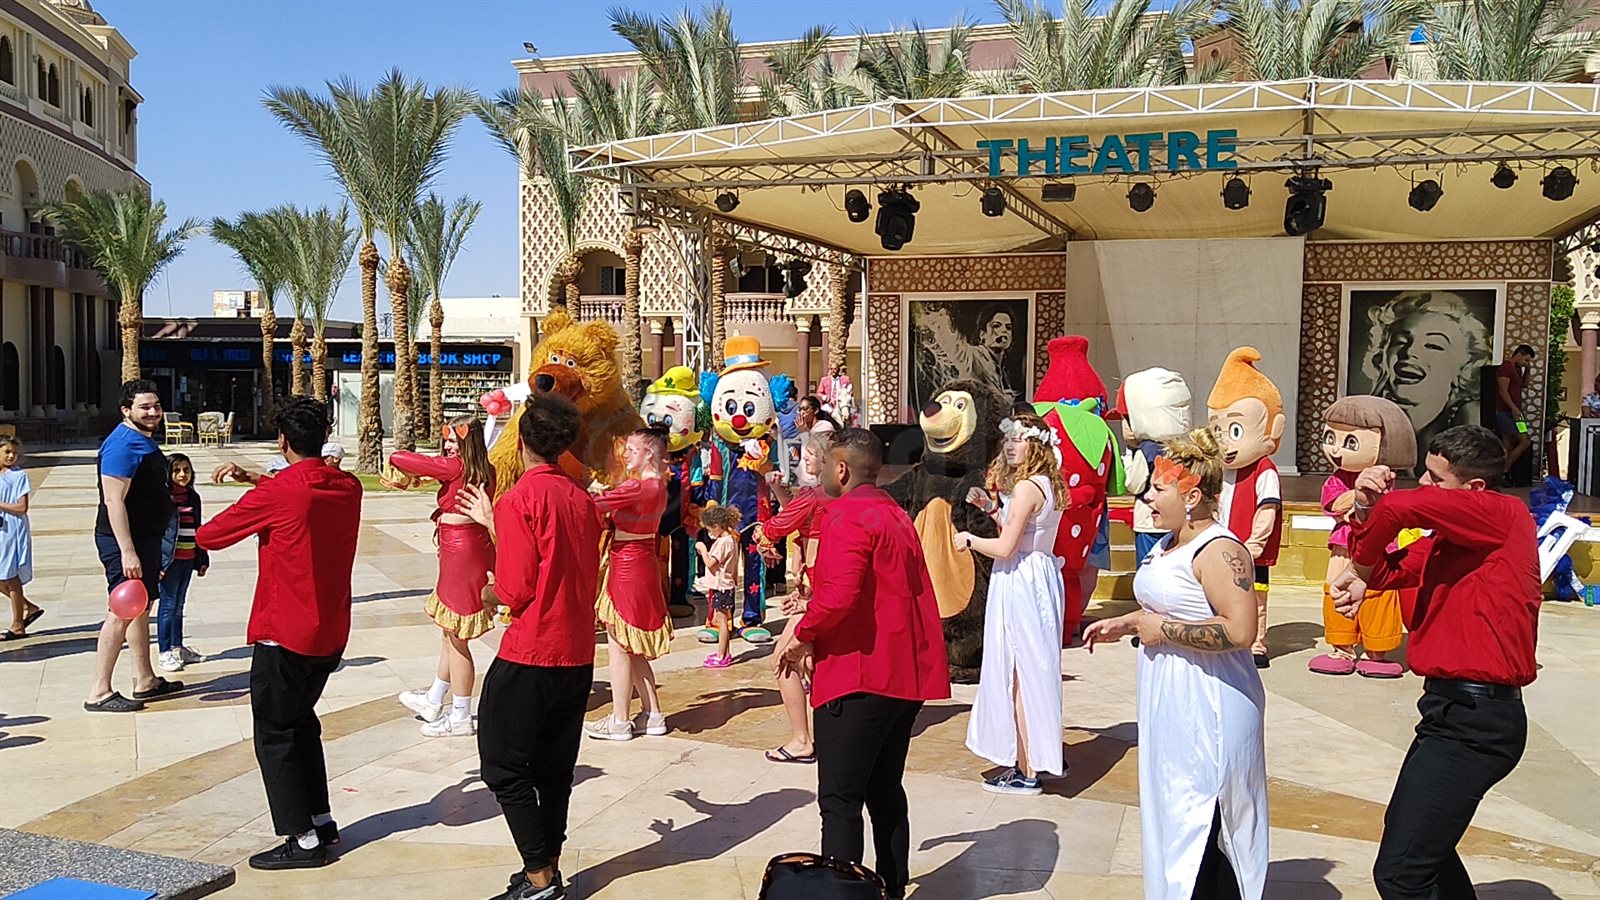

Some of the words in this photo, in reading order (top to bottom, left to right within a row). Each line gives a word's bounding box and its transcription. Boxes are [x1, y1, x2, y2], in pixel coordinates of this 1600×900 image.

[976, 128, 1238, 177] THEATRE
[418, 353, 459, 365] BOOK
[462, 353, 502, 365] SHOP
